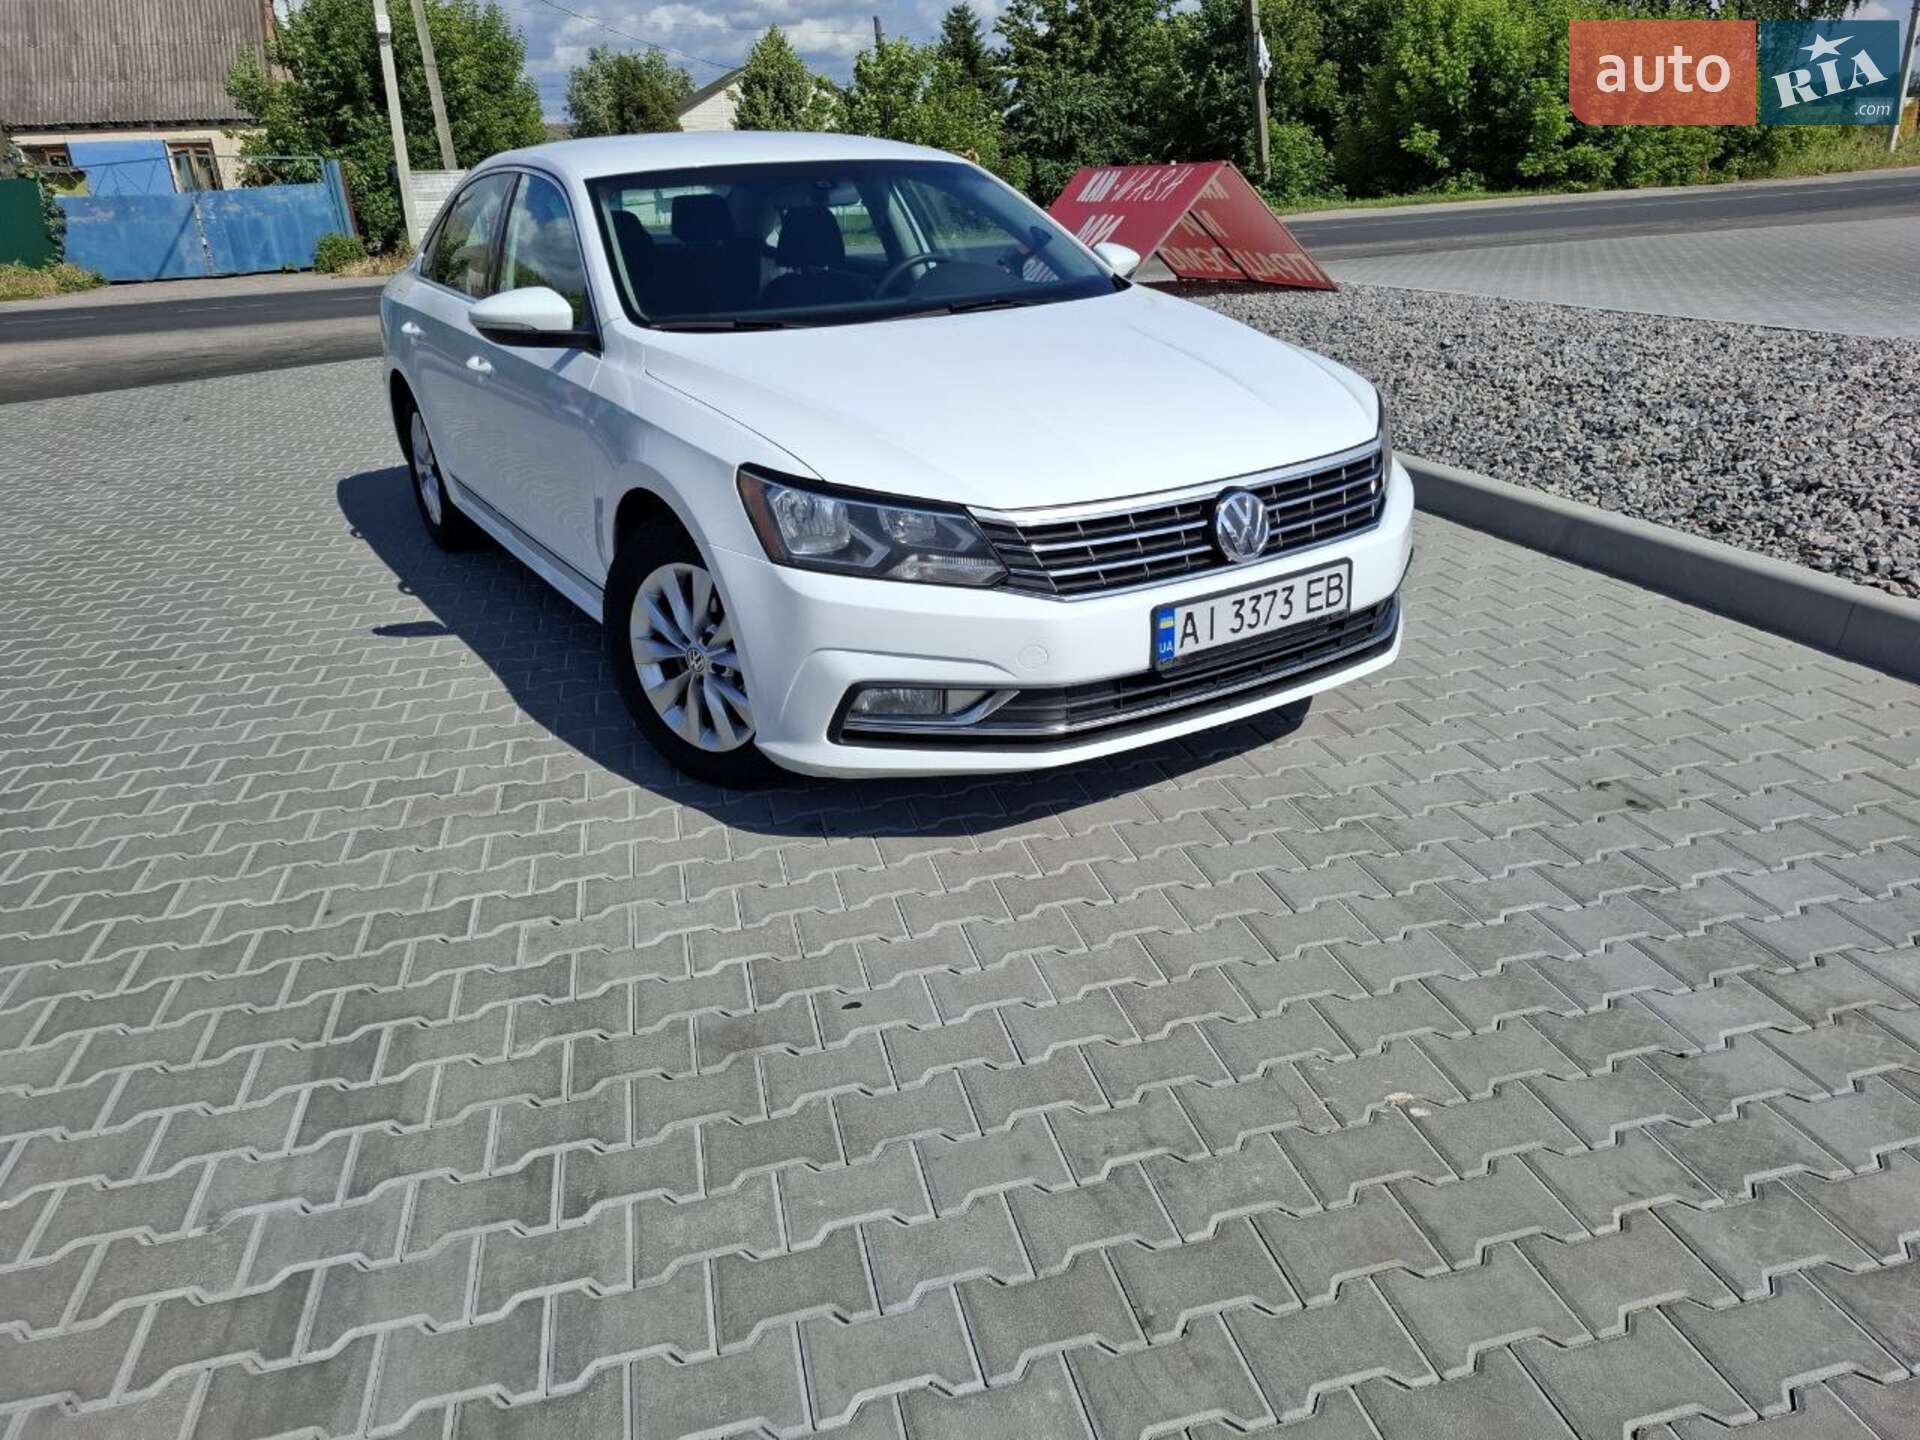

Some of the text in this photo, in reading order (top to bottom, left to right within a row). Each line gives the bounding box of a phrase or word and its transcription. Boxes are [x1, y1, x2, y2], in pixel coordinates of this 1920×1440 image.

[1180, 572, 1344, 649] AI 3373 EB
[1159, 640, 1174, 654] UA
